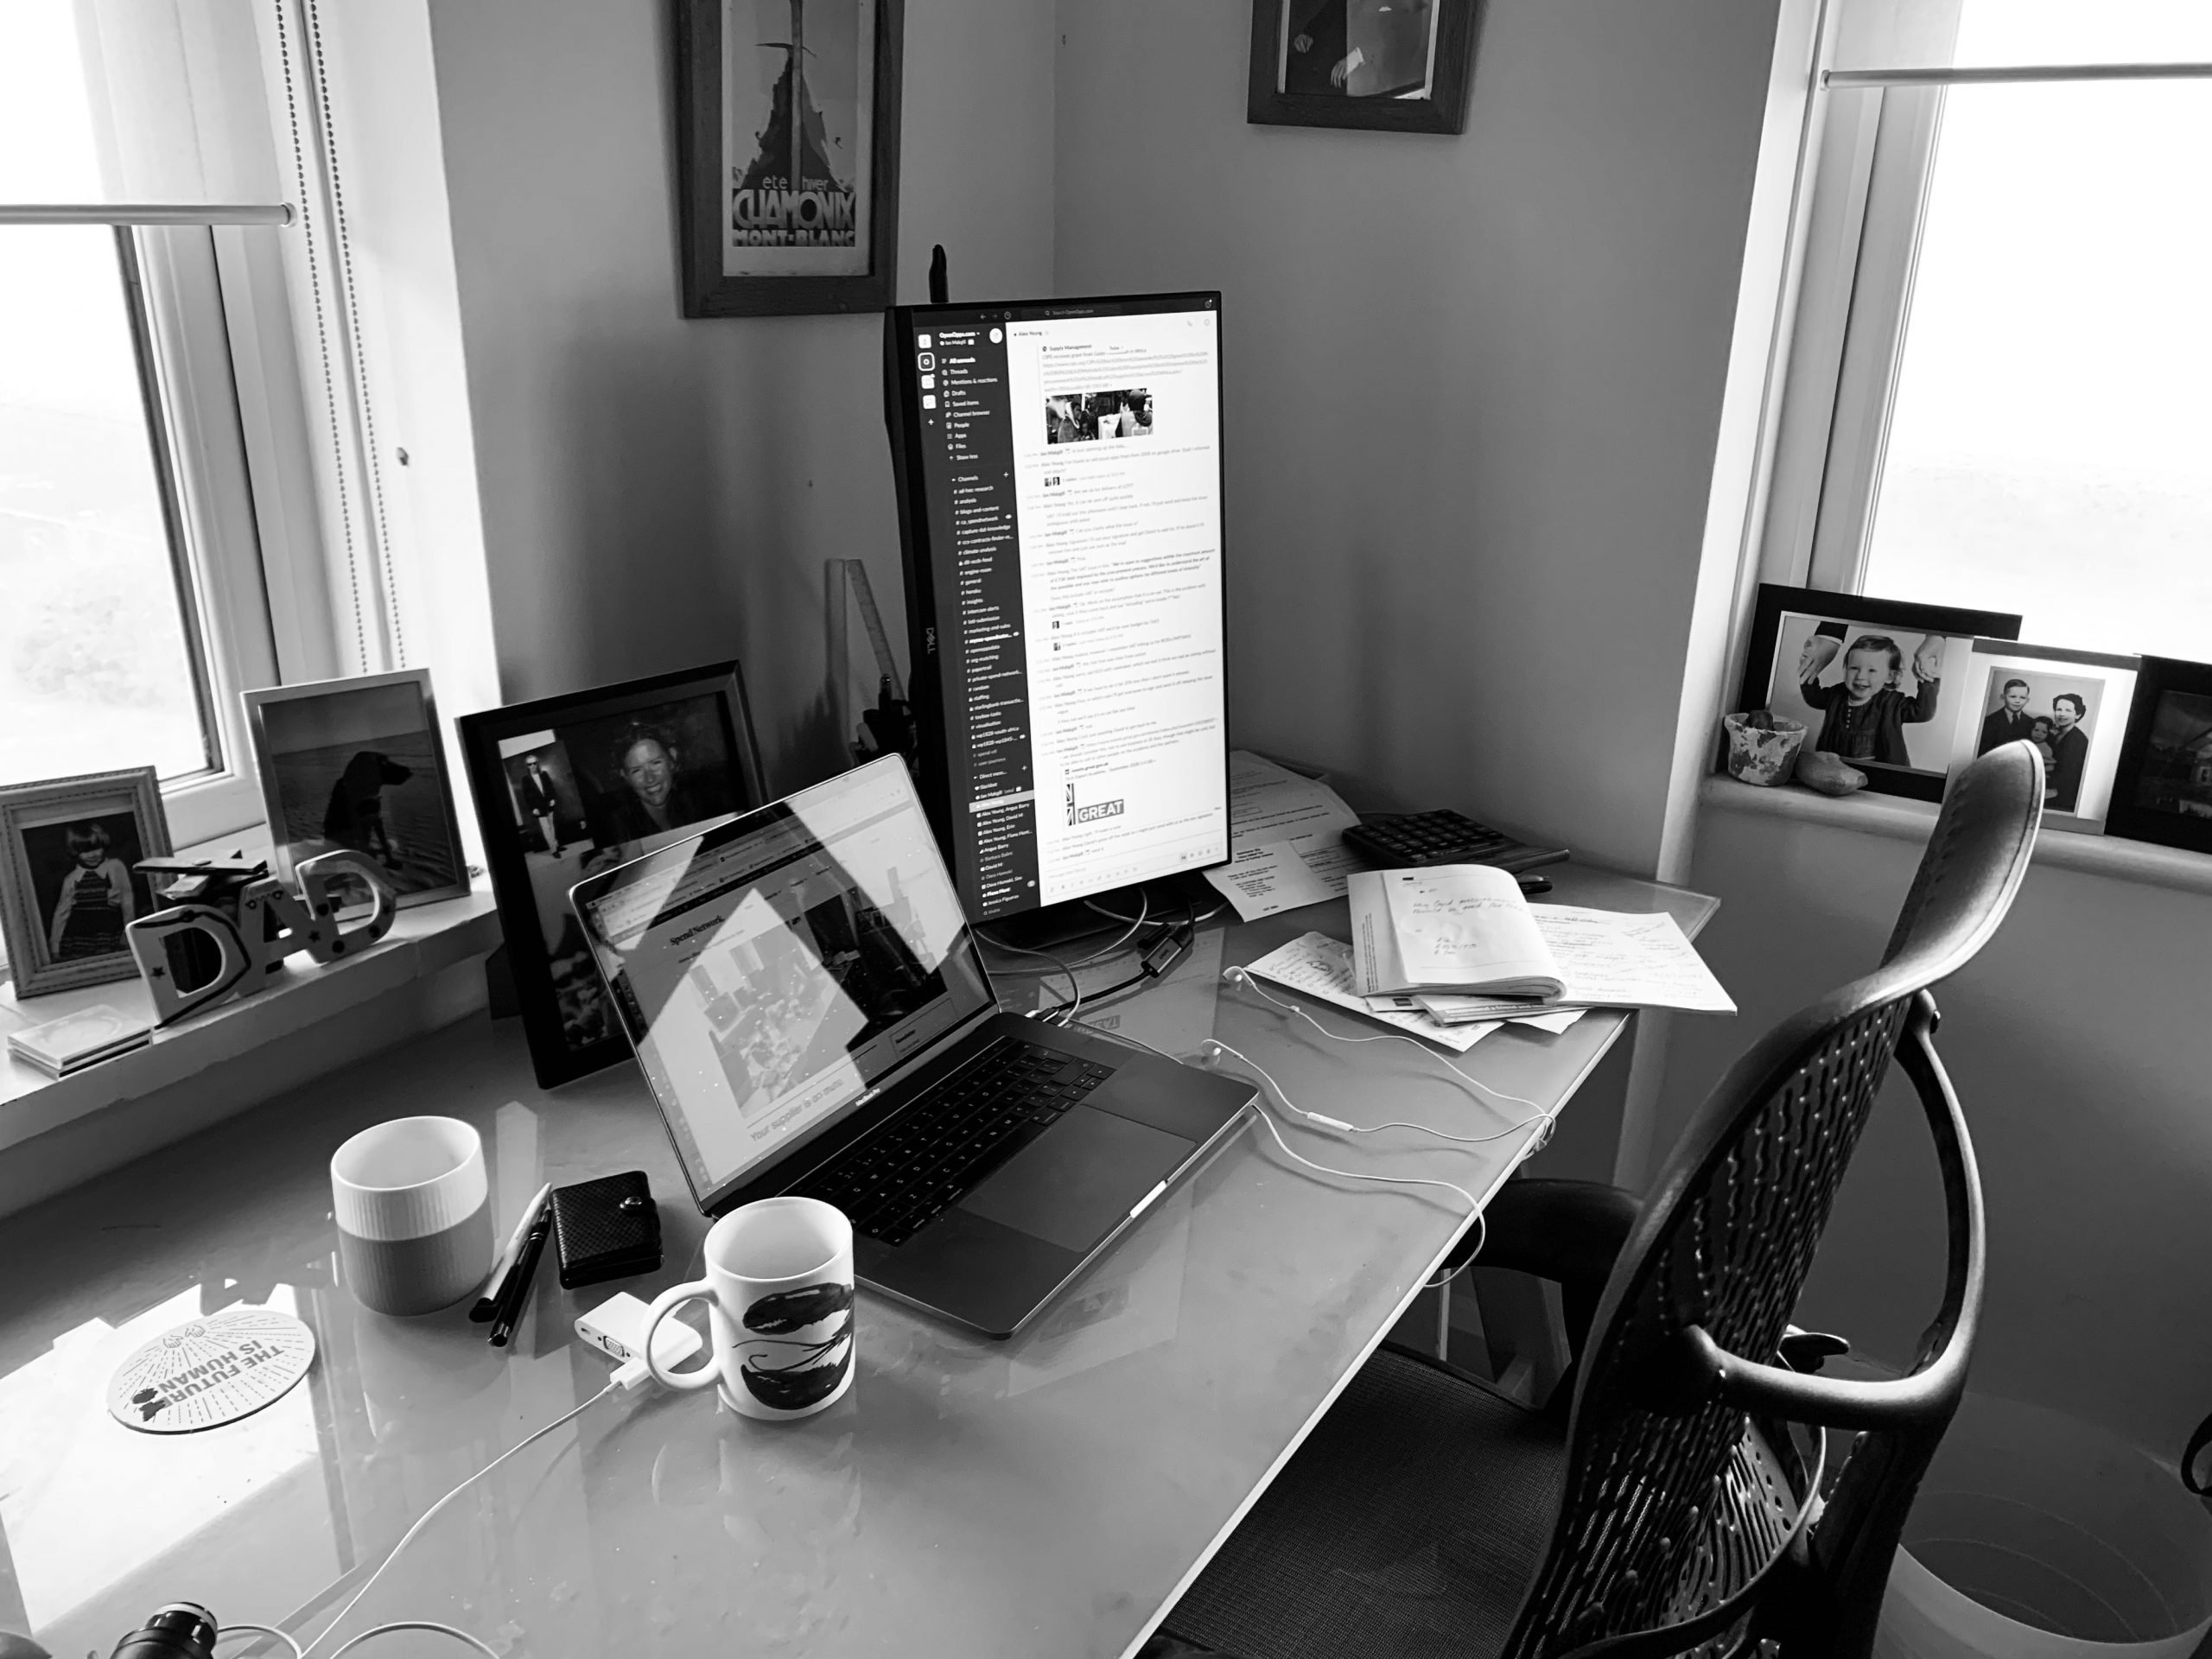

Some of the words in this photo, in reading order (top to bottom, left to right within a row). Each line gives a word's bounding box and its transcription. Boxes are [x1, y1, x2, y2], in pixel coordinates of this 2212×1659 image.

[732, 189, 856, 230] CHAMONIX
[732, 229, 856, 247] MONT-BLANC
[925, 626, 934, 655] DELL
[1078, 800, 1123, 823] GREAT
[125, 849, 397, 1030] DAD
[669, 926, 692, 947] Spend
[238, 1339, 263, 1355] IS
[241, 1344, 285, 1370] THE
[157, 1351, 238, 1394] HUMAN
[164, 1363, 241, 1408] FUTURE
